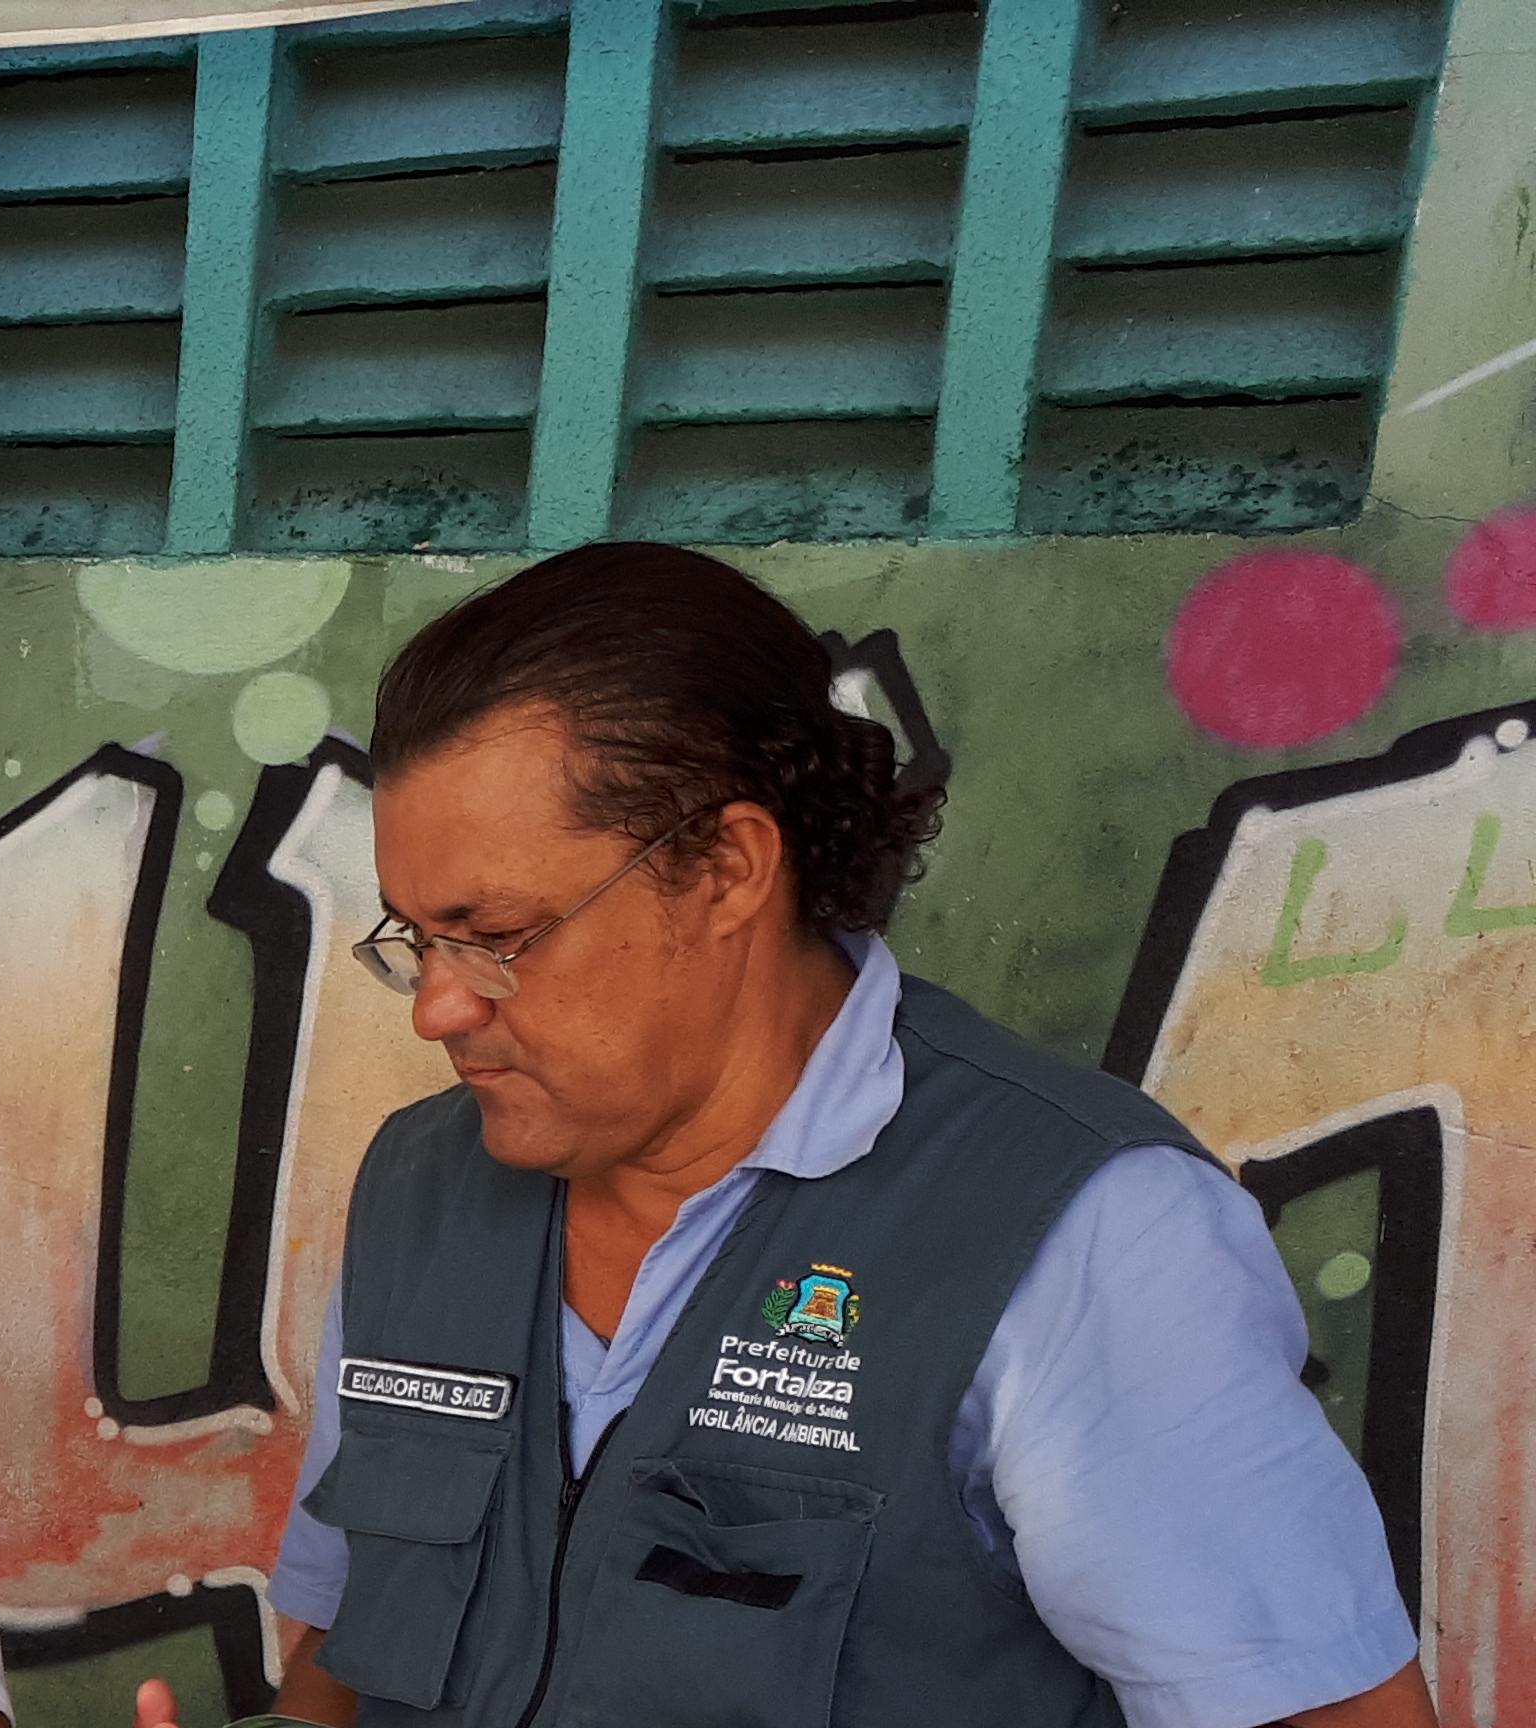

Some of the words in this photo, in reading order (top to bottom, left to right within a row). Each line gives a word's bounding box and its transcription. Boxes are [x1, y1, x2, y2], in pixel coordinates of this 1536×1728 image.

[835, 1350, 861, 1372] de
[422, 1382, 446, 1404] EM
[712, 1357, 854, 1404] Fortaleza
[688, 1406, 778, 1438] VIGILÂNCIA
